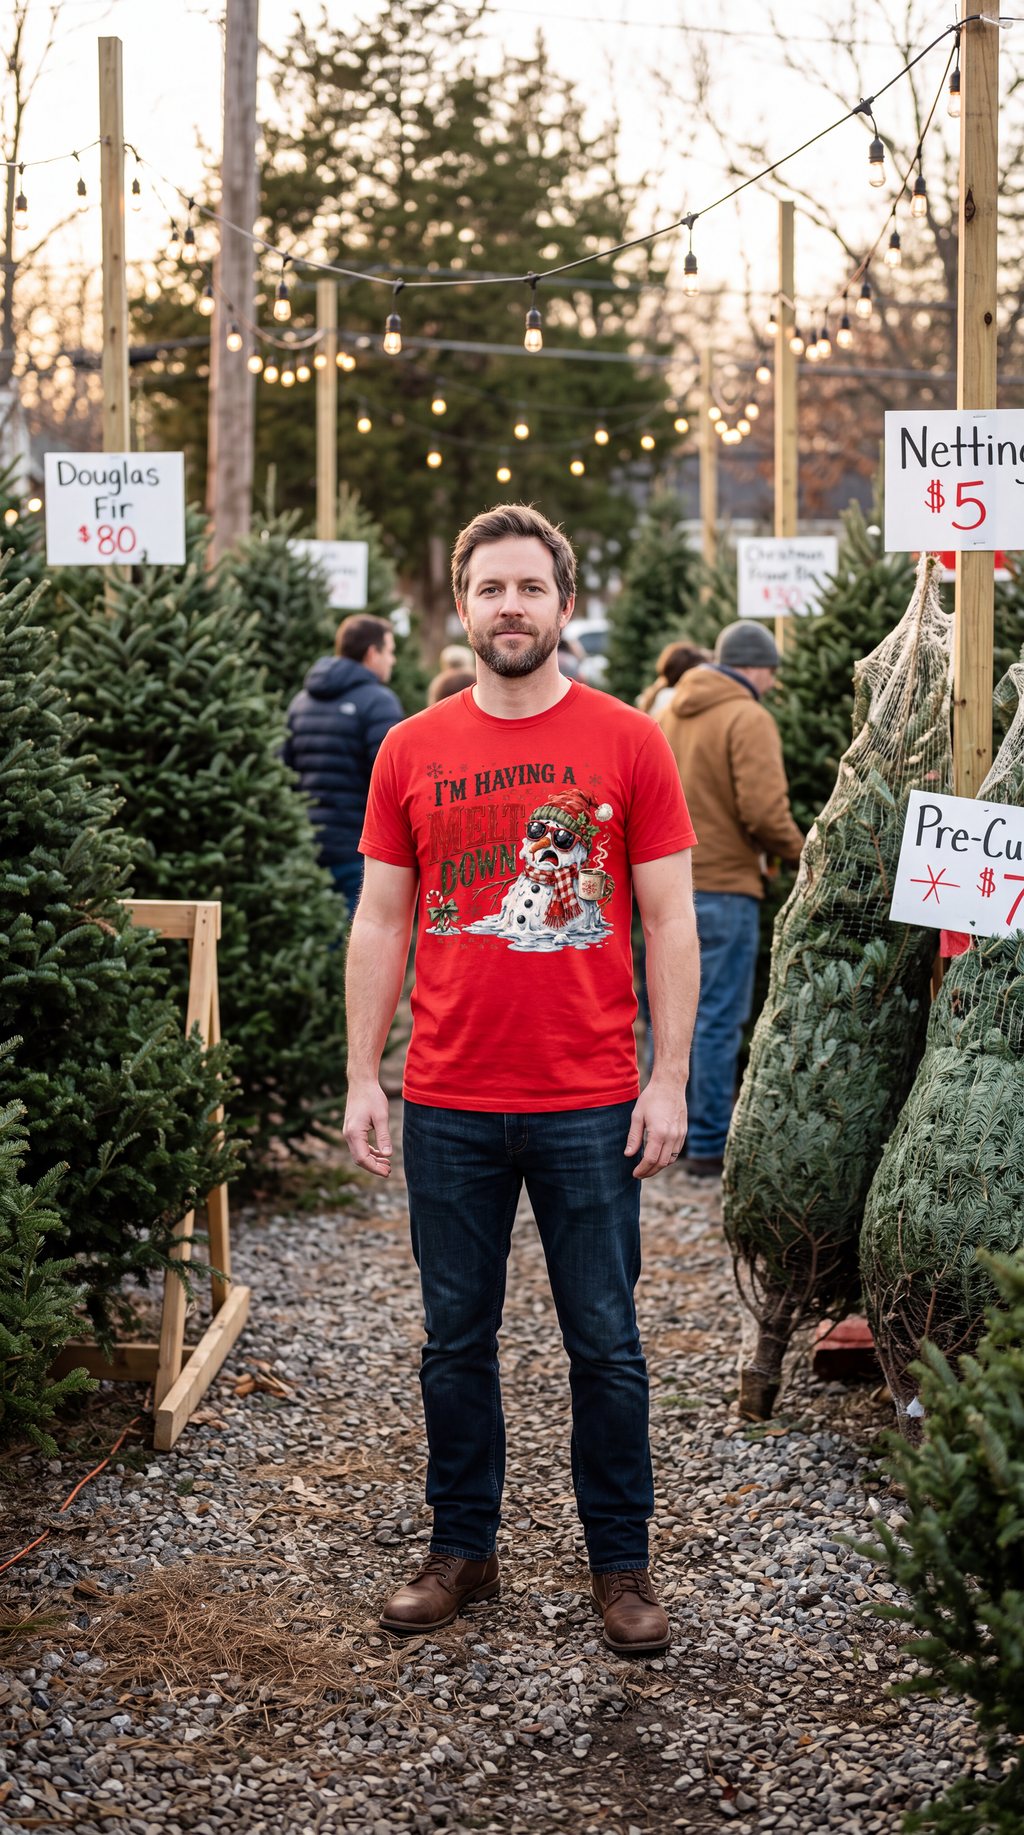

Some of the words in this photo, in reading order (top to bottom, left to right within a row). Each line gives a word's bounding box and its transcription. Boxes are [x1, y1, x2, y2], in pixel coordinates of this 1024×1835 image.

[57, 460, 160, 496] Douglas
[94, 496, 134, 519] Fir
[924, 479, 987, 530] $5
[77, 524, 136, 556] $80
[434, 778, 467, 807] I'M
[474, 763, 556, 797] HAVING
[562, 766, 577, 785] A
[426, 803, 525, 866] MELT
[440, 843, 517, 897] DOWN
